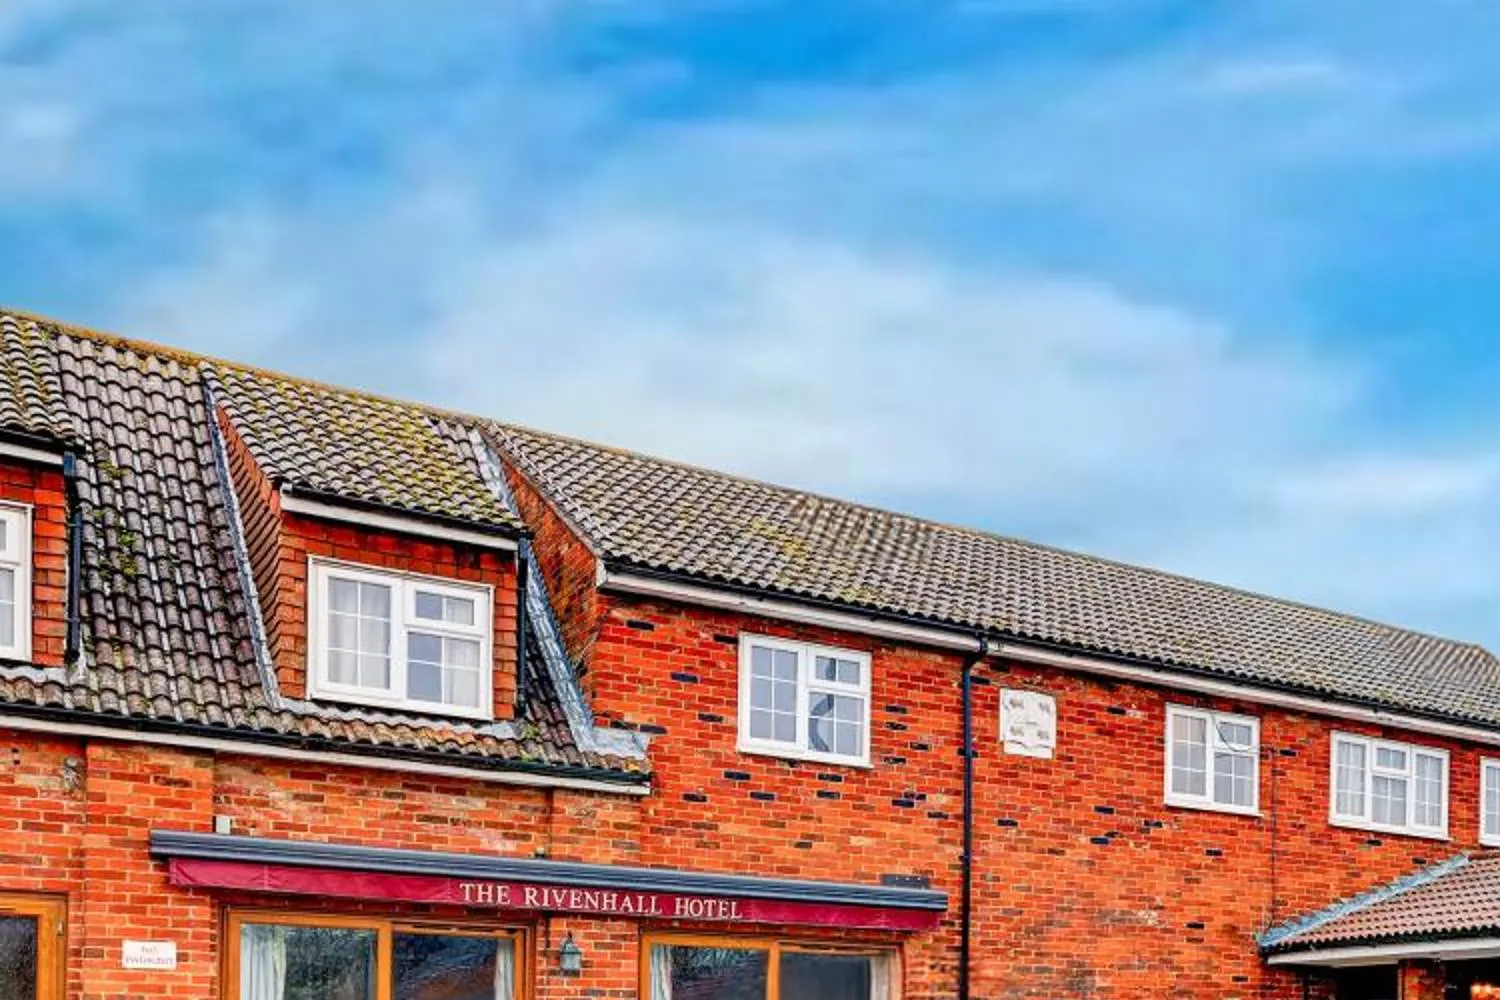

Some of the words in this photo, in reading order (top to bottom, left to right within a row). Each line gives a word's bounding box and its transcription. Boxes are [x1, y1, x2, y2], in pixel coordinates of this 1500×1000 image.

[460, 883, 511, 905] THE
[524, 887, 662, 913] RIVENHALL
[674, 897, 742, 919] HOTEL
